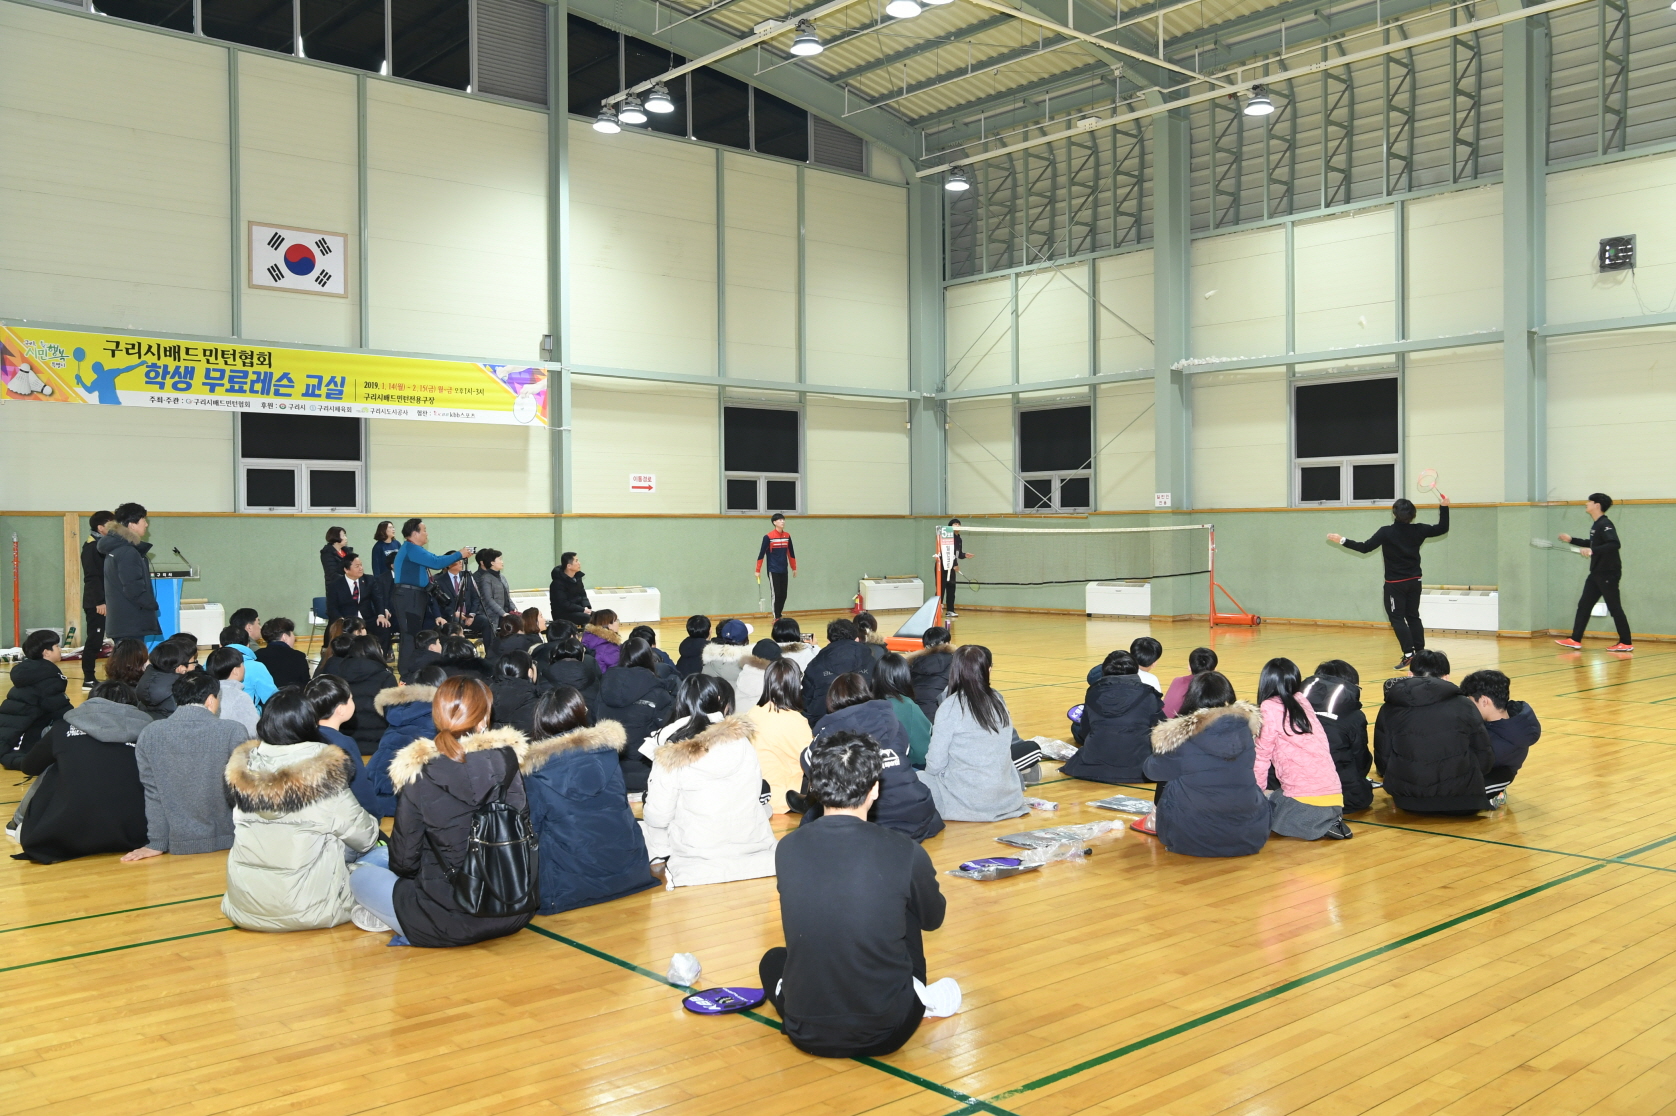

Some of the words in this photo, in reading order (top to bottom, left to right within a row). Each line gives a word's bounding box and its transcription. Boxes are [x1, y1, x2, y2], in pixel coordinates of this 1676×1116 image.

[103, 339, 272, 369] 구리시배드민턴협회
[144, 362, 196, 392] 학생
[202, 367, 295, 398] 무료레슨
[301, 374, 346, 401] 교실
[363, 381, 381, 390] 2019.
[194, 398, 251, 408] 구리시배드민턴협회
[261, 401, 274, 410] 후원
[289, 403, 306, 411] 구리시
[317, 404, 352, 413] 구리시체육회
[370, 407, 408, 416] 구리시도시공사
[364, 392, 435, 405] 구리시배드민턴전용구장
